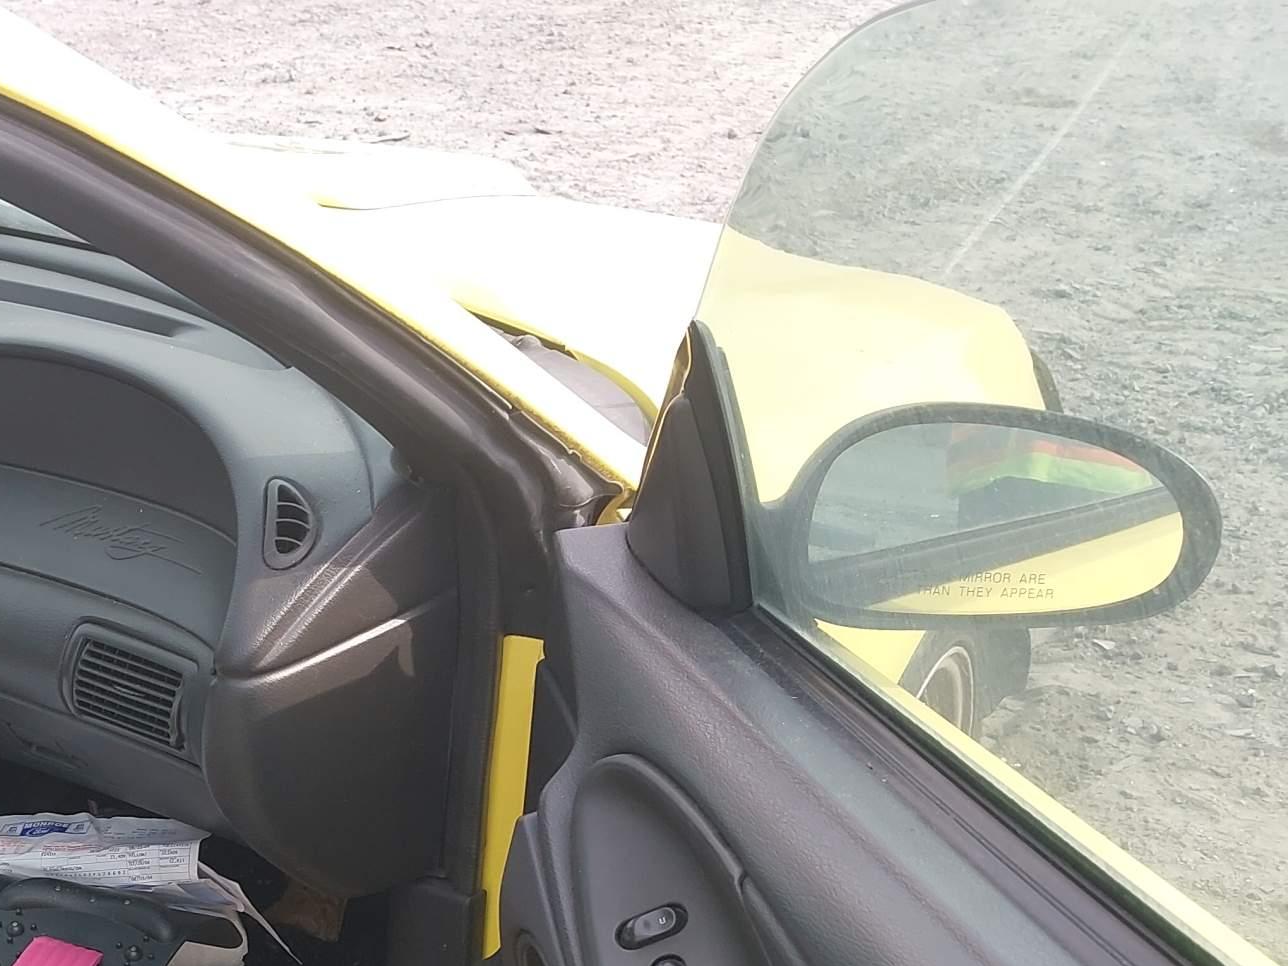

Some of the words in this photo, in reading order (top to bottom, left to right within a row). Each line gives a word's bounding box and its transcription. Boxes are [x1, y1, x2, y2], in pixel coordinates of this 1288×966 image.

[959, 572, 1011, 584] MIRROR
[1019, 573, 1046, 585] ARE
[960, 586, 992, 598] THEY
[1000, 587, 1054, 599] APPEAR
[23, 820, 70, 830] MONROE
